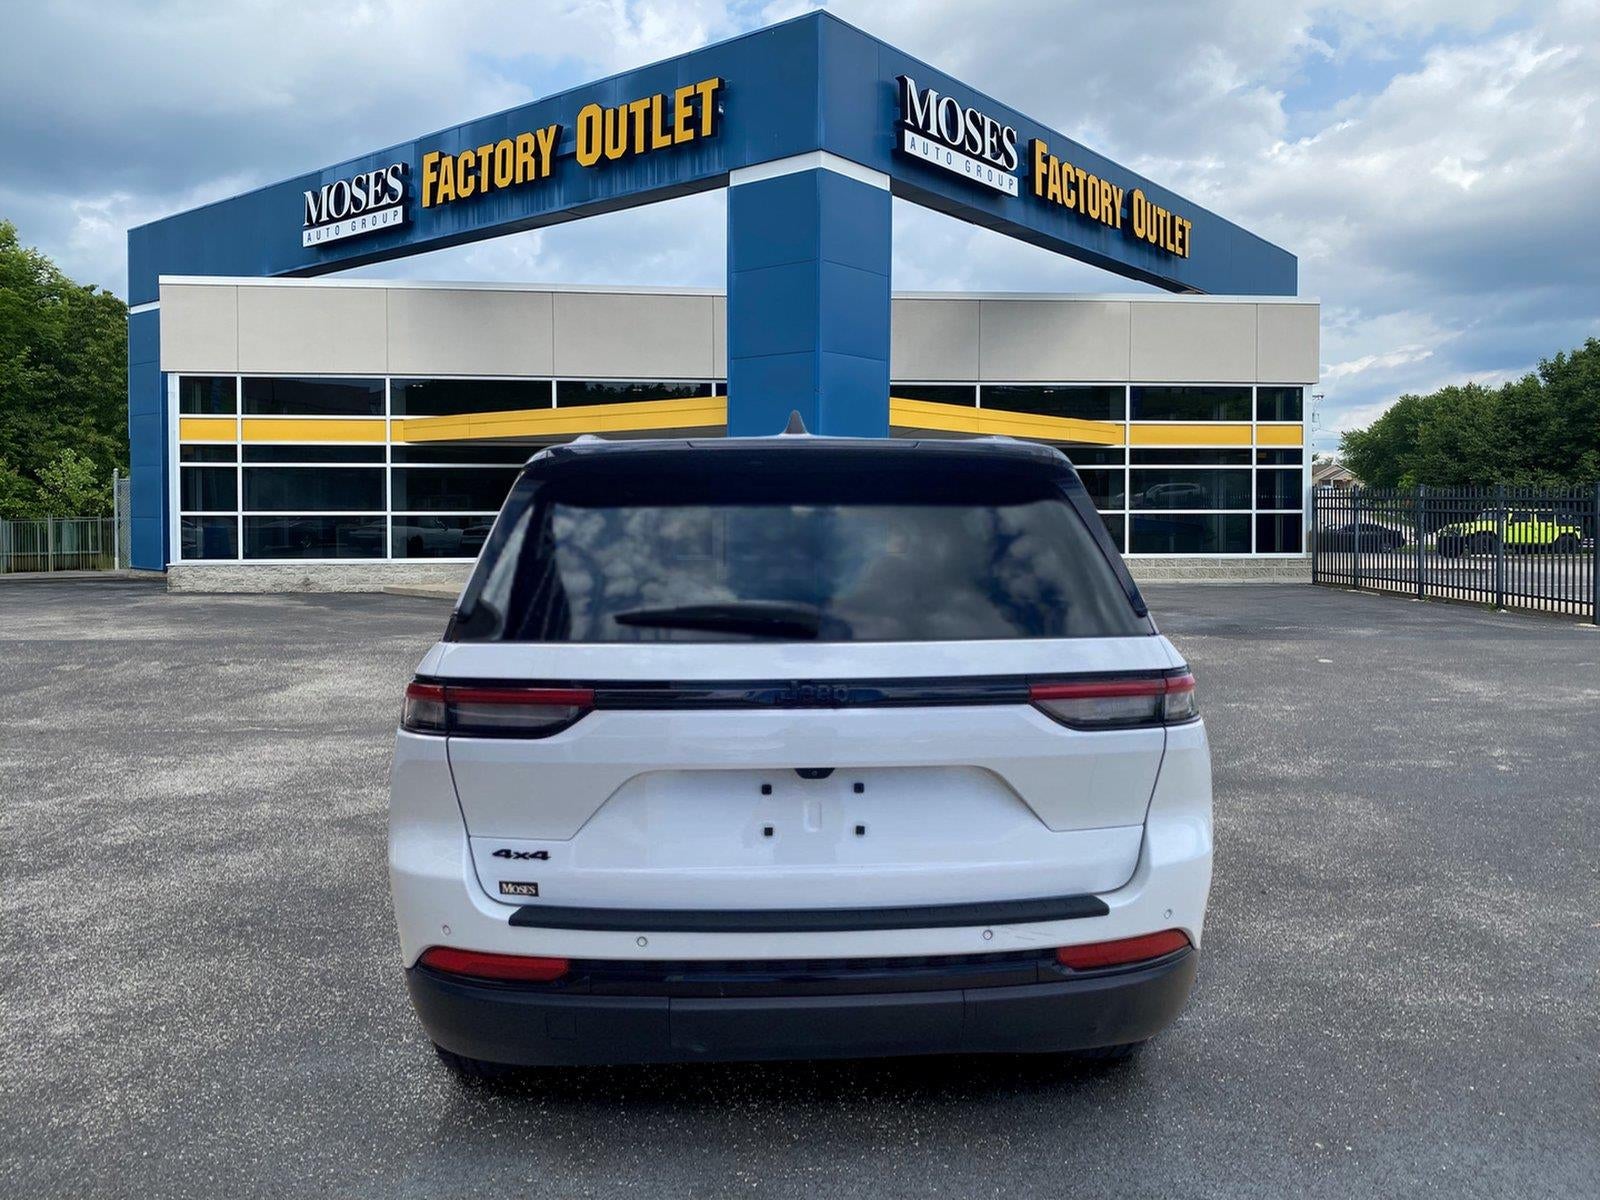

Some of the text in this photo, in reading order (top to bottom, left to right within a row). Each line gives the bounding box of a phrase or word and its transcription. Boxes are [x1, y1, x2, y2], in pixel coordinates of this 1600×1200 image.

[421, 76, 720, 208] FACTORY OUTLET
[903, 75, 1019, 171] MOSES
[303, 163, 404, 227] MOSES
[909, 139, 1015, 190] AUTO GROUP
[307, 208, 400, 243] AUTO GROUP
[1034, 138, 1192, 259] FACTORY OUTLET
[502, 883, 536, 894] MOSES
